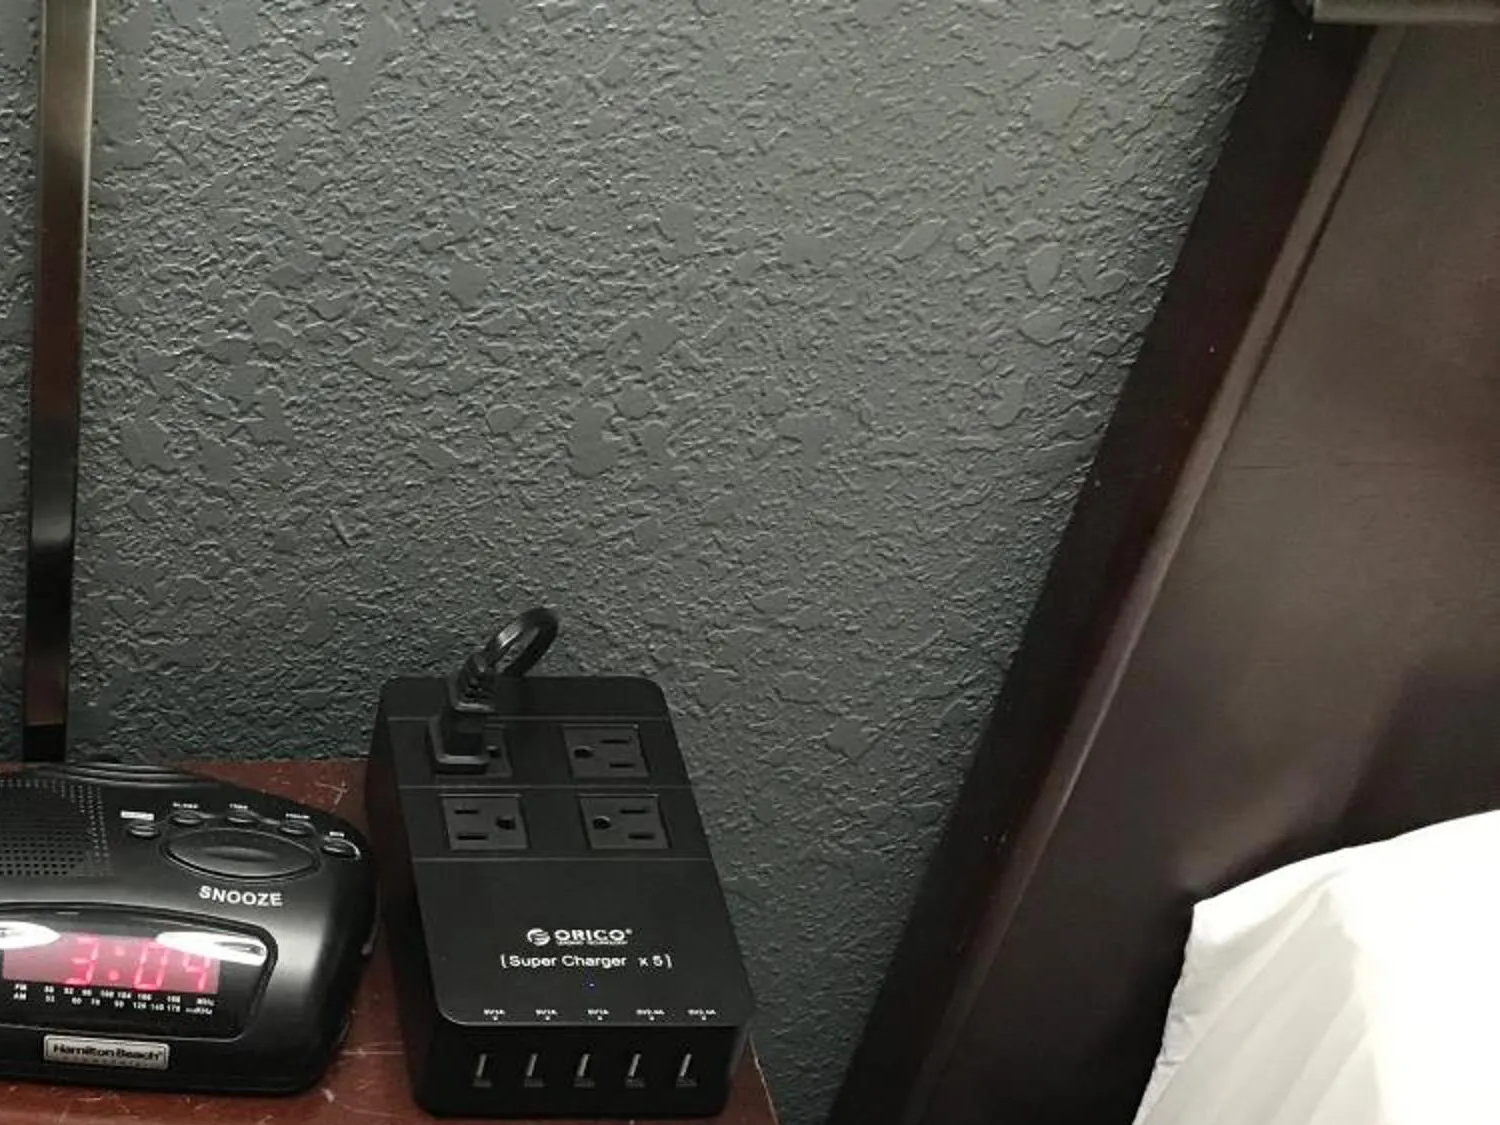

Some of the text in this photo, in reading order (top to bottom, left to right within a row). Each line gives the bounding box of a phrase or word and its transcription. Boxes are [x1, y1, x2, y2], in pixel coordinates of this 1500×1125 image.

[199, 885, 283, 907] SNOOZE
[561, 954, 628, 970] Charger
[637, 957, 649, 968] x
[52, 1043, 115, 1057] Hamilton
[116, 1047, 162, 1061] Beach
